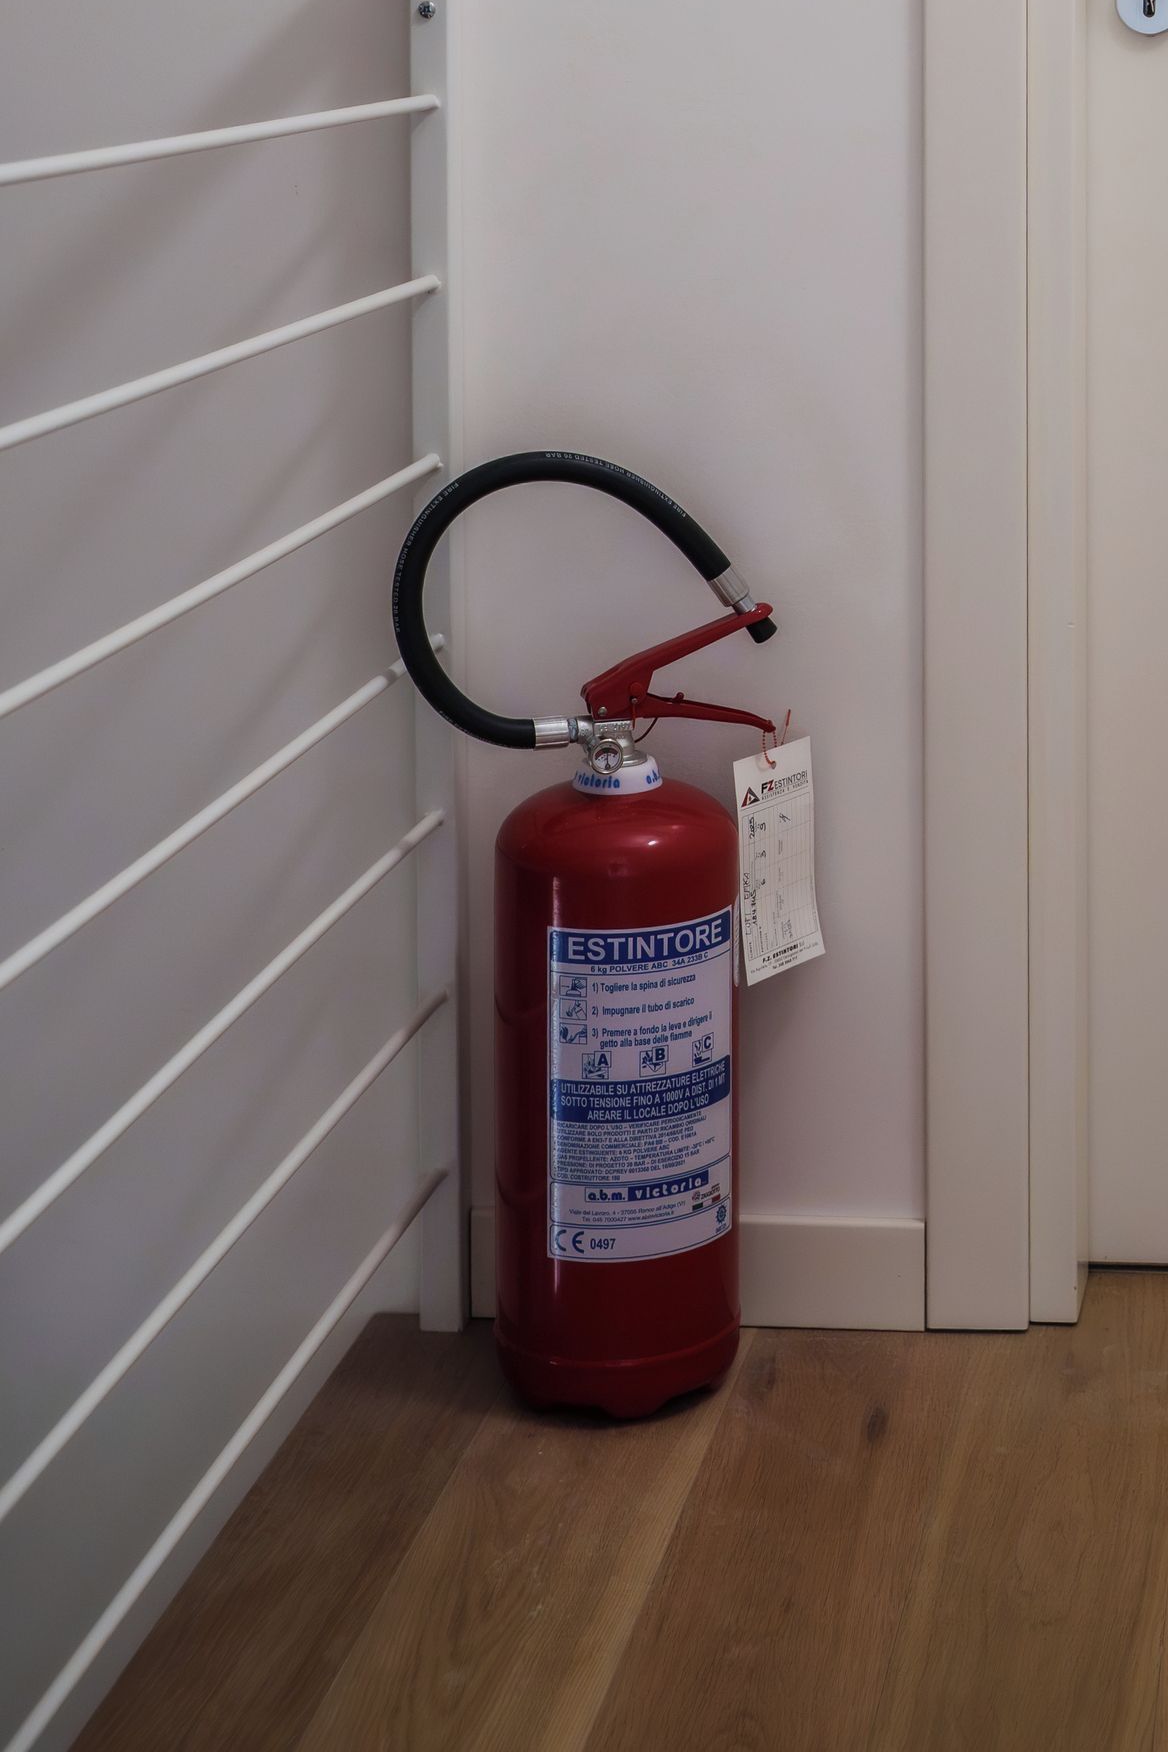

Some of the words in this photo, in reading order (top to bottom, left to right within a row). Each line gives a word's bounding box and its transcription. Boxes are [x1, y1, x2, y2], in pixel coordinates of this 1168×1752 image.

[575, 455, 603, 465] TESTED
[442, 482, 459, 496] FIRE
[406, 496, 443, 546] EXTINGUISHER
[398, 548, 409, 567] HOSE
[568, 919, 722, 960] ESTINTORE
[598, 965, 607, 973] kg
[610, 963, 649, 972] POLVERE
[651, 961, 668, 969] ABC
[592, 983, 598, 994] 1)
[601, 983, 629, 993] Togliere
[631, 982, 637, 990] la
[640, 981, 658, 992] spina
[660, 978, 666, 987] di
[668, 974, 696, 986] sicurezza
[592, 1007, 598, 1017] 2)
[603, 1006, 640, 1016] Impugnare
[642, 1004, 646, 1013] il
[648, 1004, 663, 1012] tubo
[665, 1001, 671, 1009] di
[673, 997, 694, 1008] scarico
[592, 1028, 598, 1038] 3)
[602, 1028, 631, 1037] Premere
[640, 1025, 659, 1035] fondo
[661, 1023, 666, 1032] la
[669, 1022, 681, 1030] leva
[688, 1014, 708, 1026] dirigere
[600, 1039, 618, 1049] getto
[620, 1039, 632, 1047] alla
[635, 1037, 650, 1046] base
[652, 1034, 668, 1044] delle
[670, 1030, 692, 1041] fiamme
[703, 1036, 712, 1049] C
[598, 1054, 608, 1066] A
[655, 1048, 665, 1061] B
[561, 1083, 614, 1095] UTILIZZABILE
[617, 1083, 628, 1094] SU
[630, 1075, 690, 1094] ATTREZZATURE
[692, 1061, 726, 1082] ELETTRICHE
[561, 1096, 588, 1108] SOTTO
[590, 1096, 631, 1108] TENSIONE
[633, 1094, 652, 1106] FINO
[654, 1094, 660, 1104] A
[662, 1090, 684, 1102] 1000V
[685, 1087, 690, 1098] A
[692, 1082, 708, 1096] DIST.
[708, 1079, 714, 1091] DI
[587, 1109, 622, 1121] AREARE
[624, 1109, 631, 1120] IL
[633, 1104, 666, 1119] LOCALE
[668, 1100, 688, 1114] DOPO
[690, 1094, 709, 1109] L'USO
[628, 1120, 658, 1128] VERIFICARE
[661, 1110, 701, 1124] PERIODICAMENTE
[557, 1134, 585, 1142] CONFORME
[629, 1133, 656, 1141] DIRETTIVA
[633, 1145, 657, 1153] POLVERE
[634, 1149, 672, 1159] TEMPERATURA
[657, 1153, 683, 1163] ESERCIZIO
[588, 1189, 625, 1200] a.b.m.
[635, 1177, 702, 1199] victoria
[590, 1239, 616, 1250] 0497
